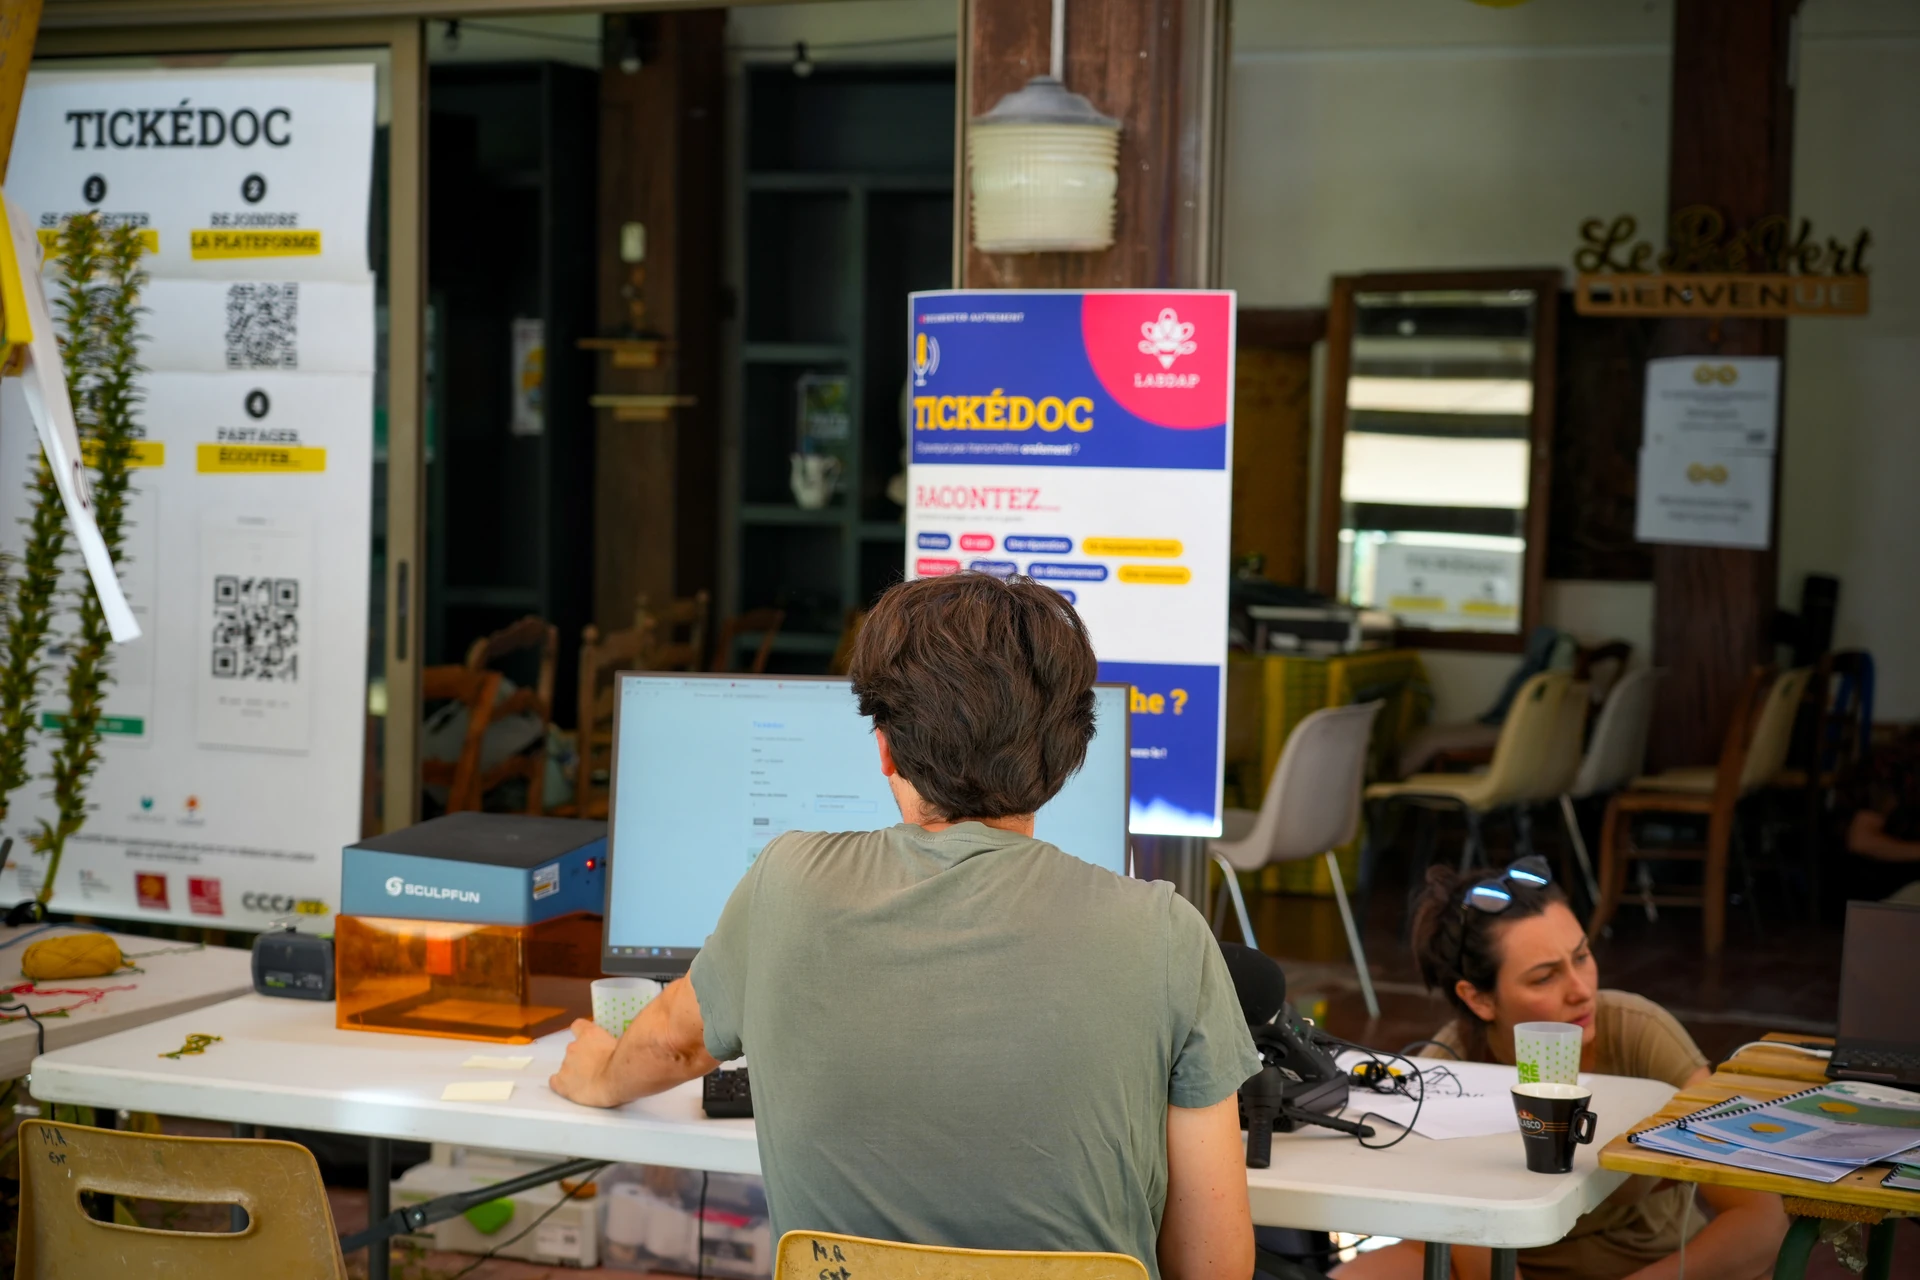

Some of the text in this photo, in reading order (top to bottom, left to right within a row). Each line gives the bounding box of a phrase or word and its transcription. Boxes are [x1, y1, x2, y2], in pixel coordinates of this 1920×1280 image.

[66, 98, 292, 149] TICKÉDOC
[210, 212, 299, 229] REJOINDRE
[214, 233, 319, 250] PLATEFORME
[1586, 281, 1858, 309] BIENVENUE
[914, 387, 1093, 431] TICKÉDOC
[404, 883, 480, 904] SCULPFUN
